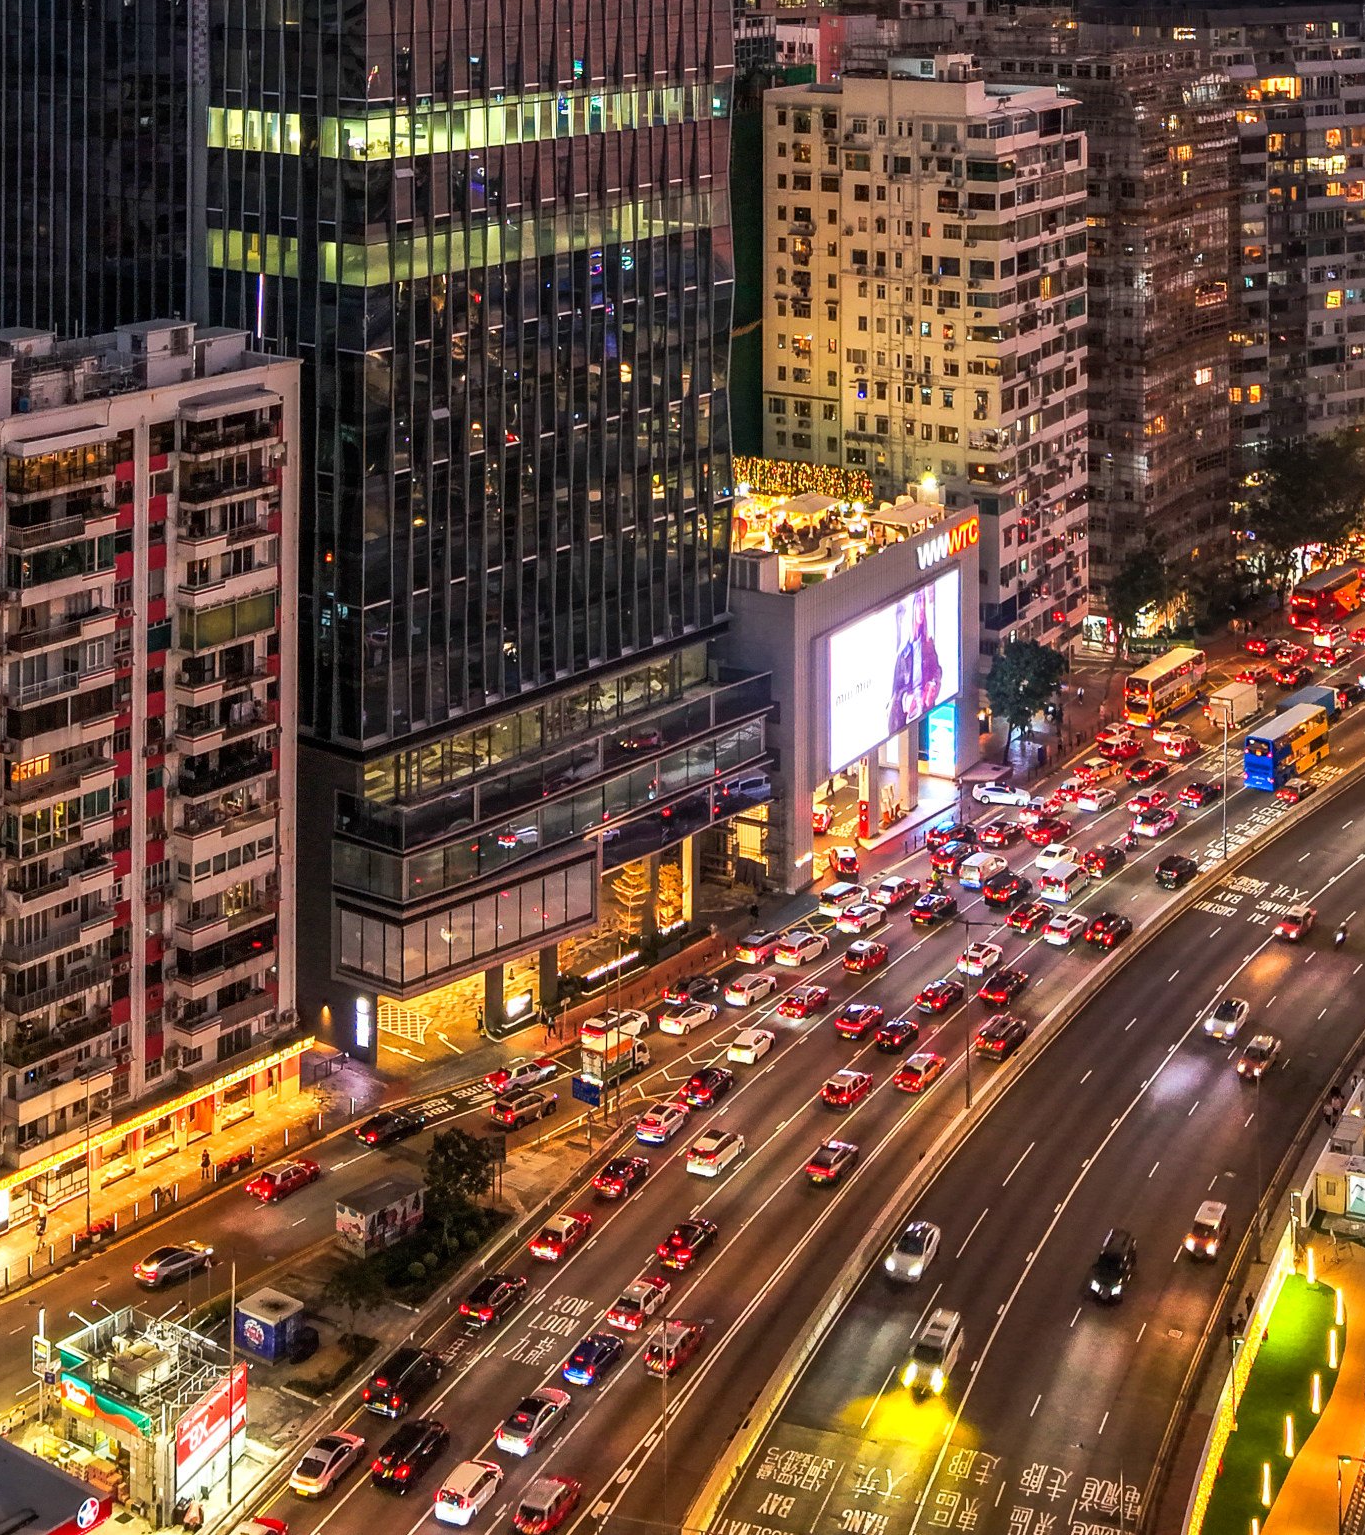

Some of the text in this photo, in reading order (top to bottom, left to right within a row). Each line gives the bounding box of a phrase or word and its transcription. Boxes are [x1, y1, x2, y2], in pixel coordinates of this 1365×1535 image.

[1214, 891, 1244, 905] BAY
[1255, 900, 1291, 915] HANG
[1247, 912, 1271, 925] TAI
[548, 1294, 594, 1317] KOW
[527, 1311, 580, 1337] LOON
[947, 1447, 1002, 1486] 走廊
[1018, 1462, 1074, 1502] 走廊
[757, 1492, 796, 1518] BAY
[927, 1489, 983, 1532] 東區
[837, 1509, 890, 1535] HANG
